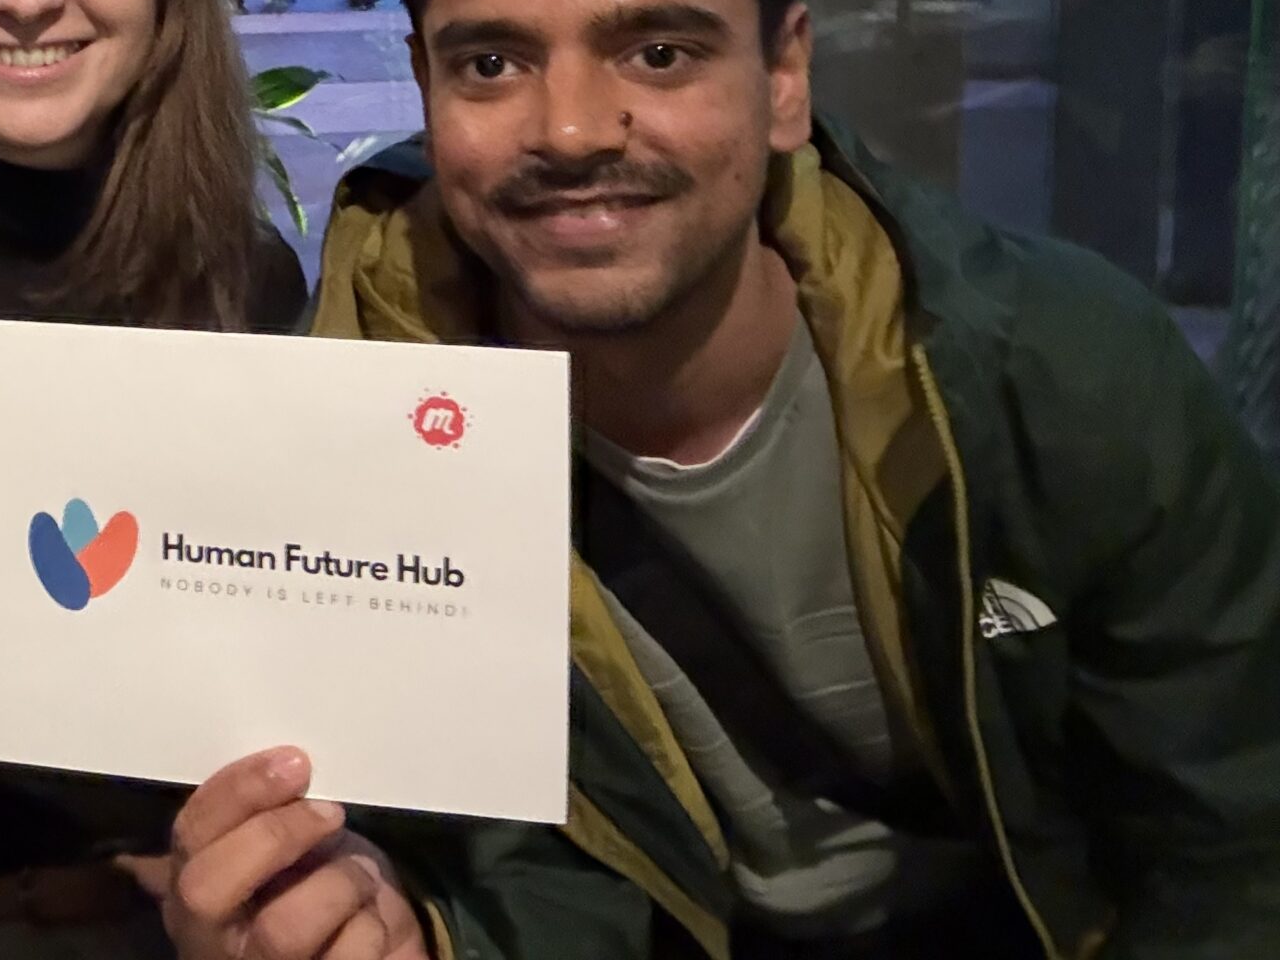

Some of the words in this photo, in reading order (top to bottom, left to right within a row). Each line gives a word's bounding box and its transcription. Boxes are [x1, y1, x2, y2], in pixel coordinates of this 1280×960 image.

[162, 532, 276, 570] Human
[284, 543, 388, 581] Future
[397, 553, 465, 588] Hub
[160, 577, 253, 597] NOBODY
[267, 586, 288, 601] IS
[302, 591, 353, 607] LEFT
